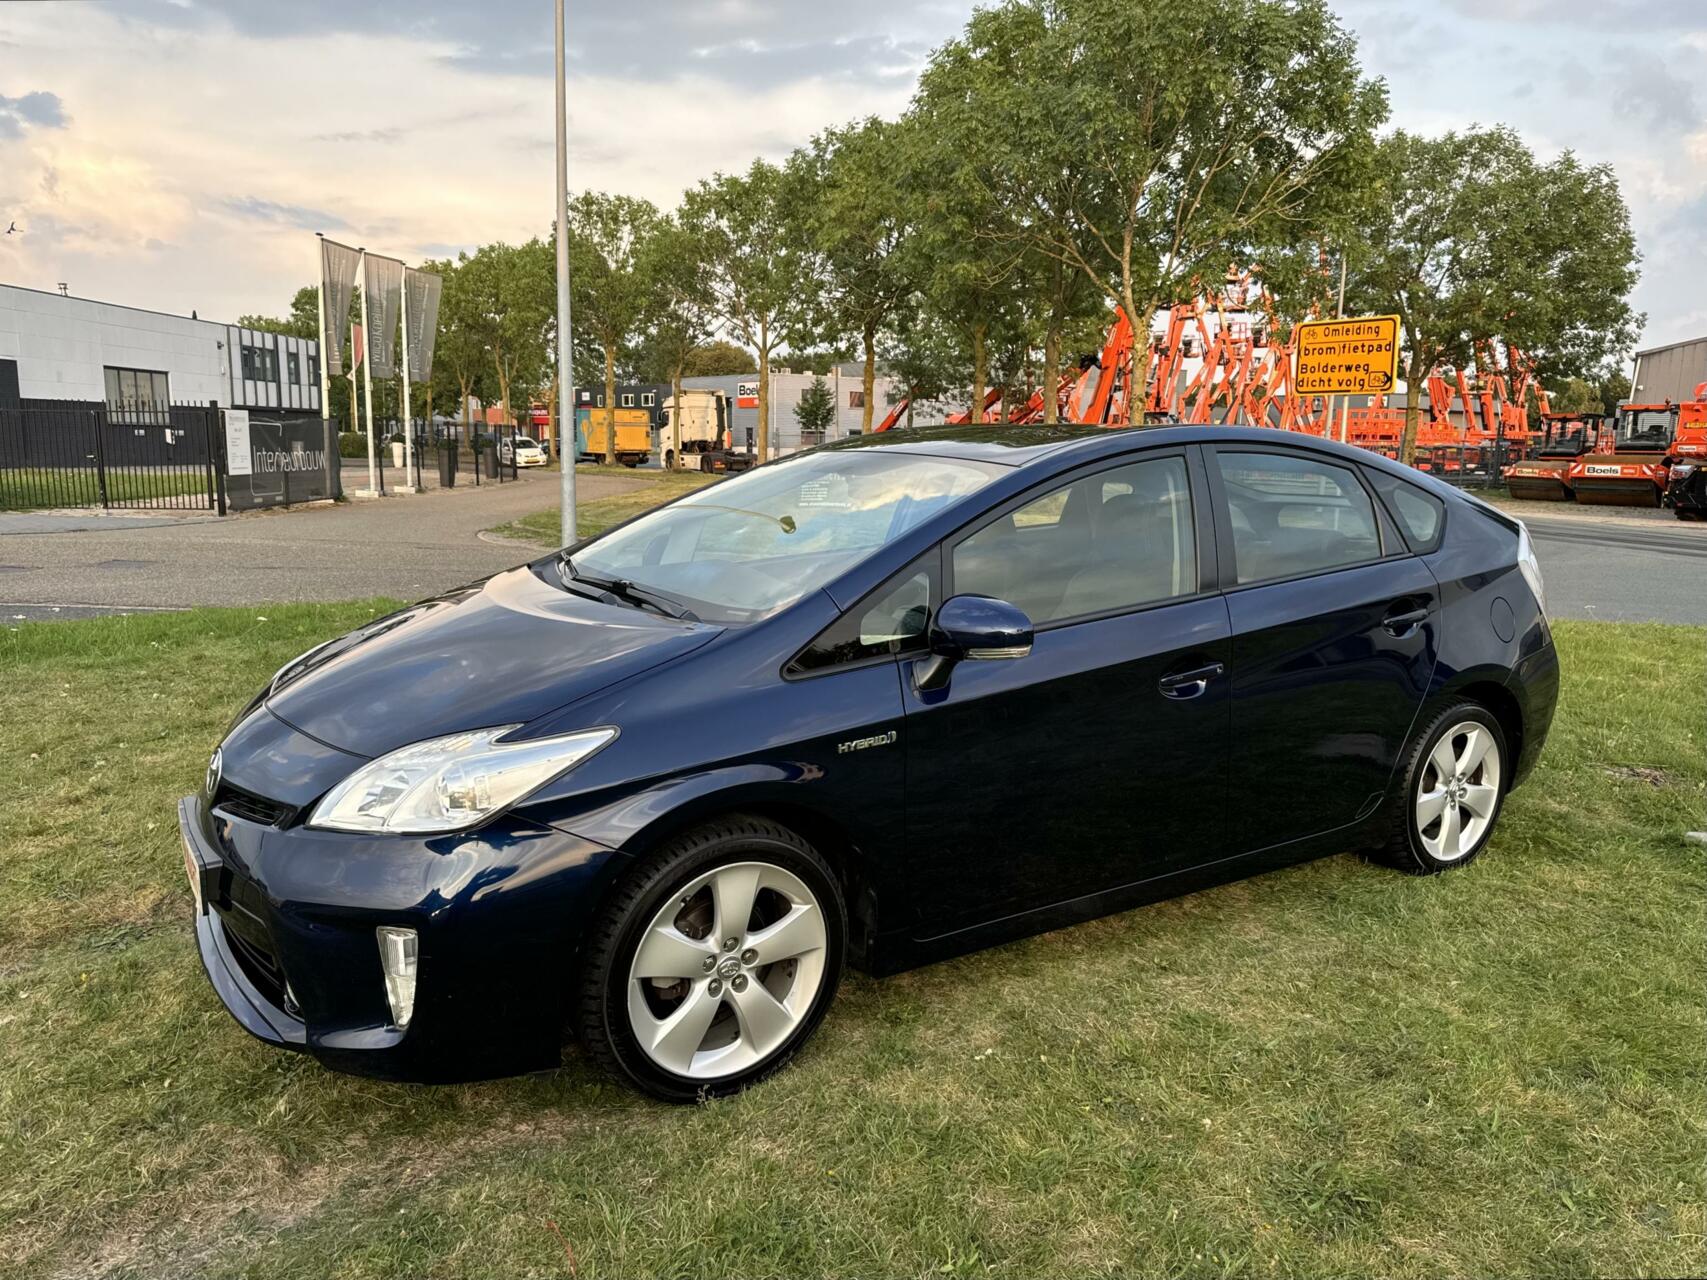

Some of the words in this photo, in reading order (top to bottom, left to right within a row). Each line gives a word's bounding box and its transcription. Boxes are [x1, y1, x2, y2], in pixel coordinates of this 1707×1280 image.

[1323, 325, 1380, 337] Omleiding
[1299, 341, 1392, 357] (brom)fietpad
[1300, 363, 1370, 375] Bolderweg
[1298, 377, 1332, 388] dicht
[1337, 376, 1365, 390] volg
[253, 445, 326, 473] Interieurbouw
[1586, 466, 1619, 475] Boels
[838, 734, 888, 754] HYBRID
